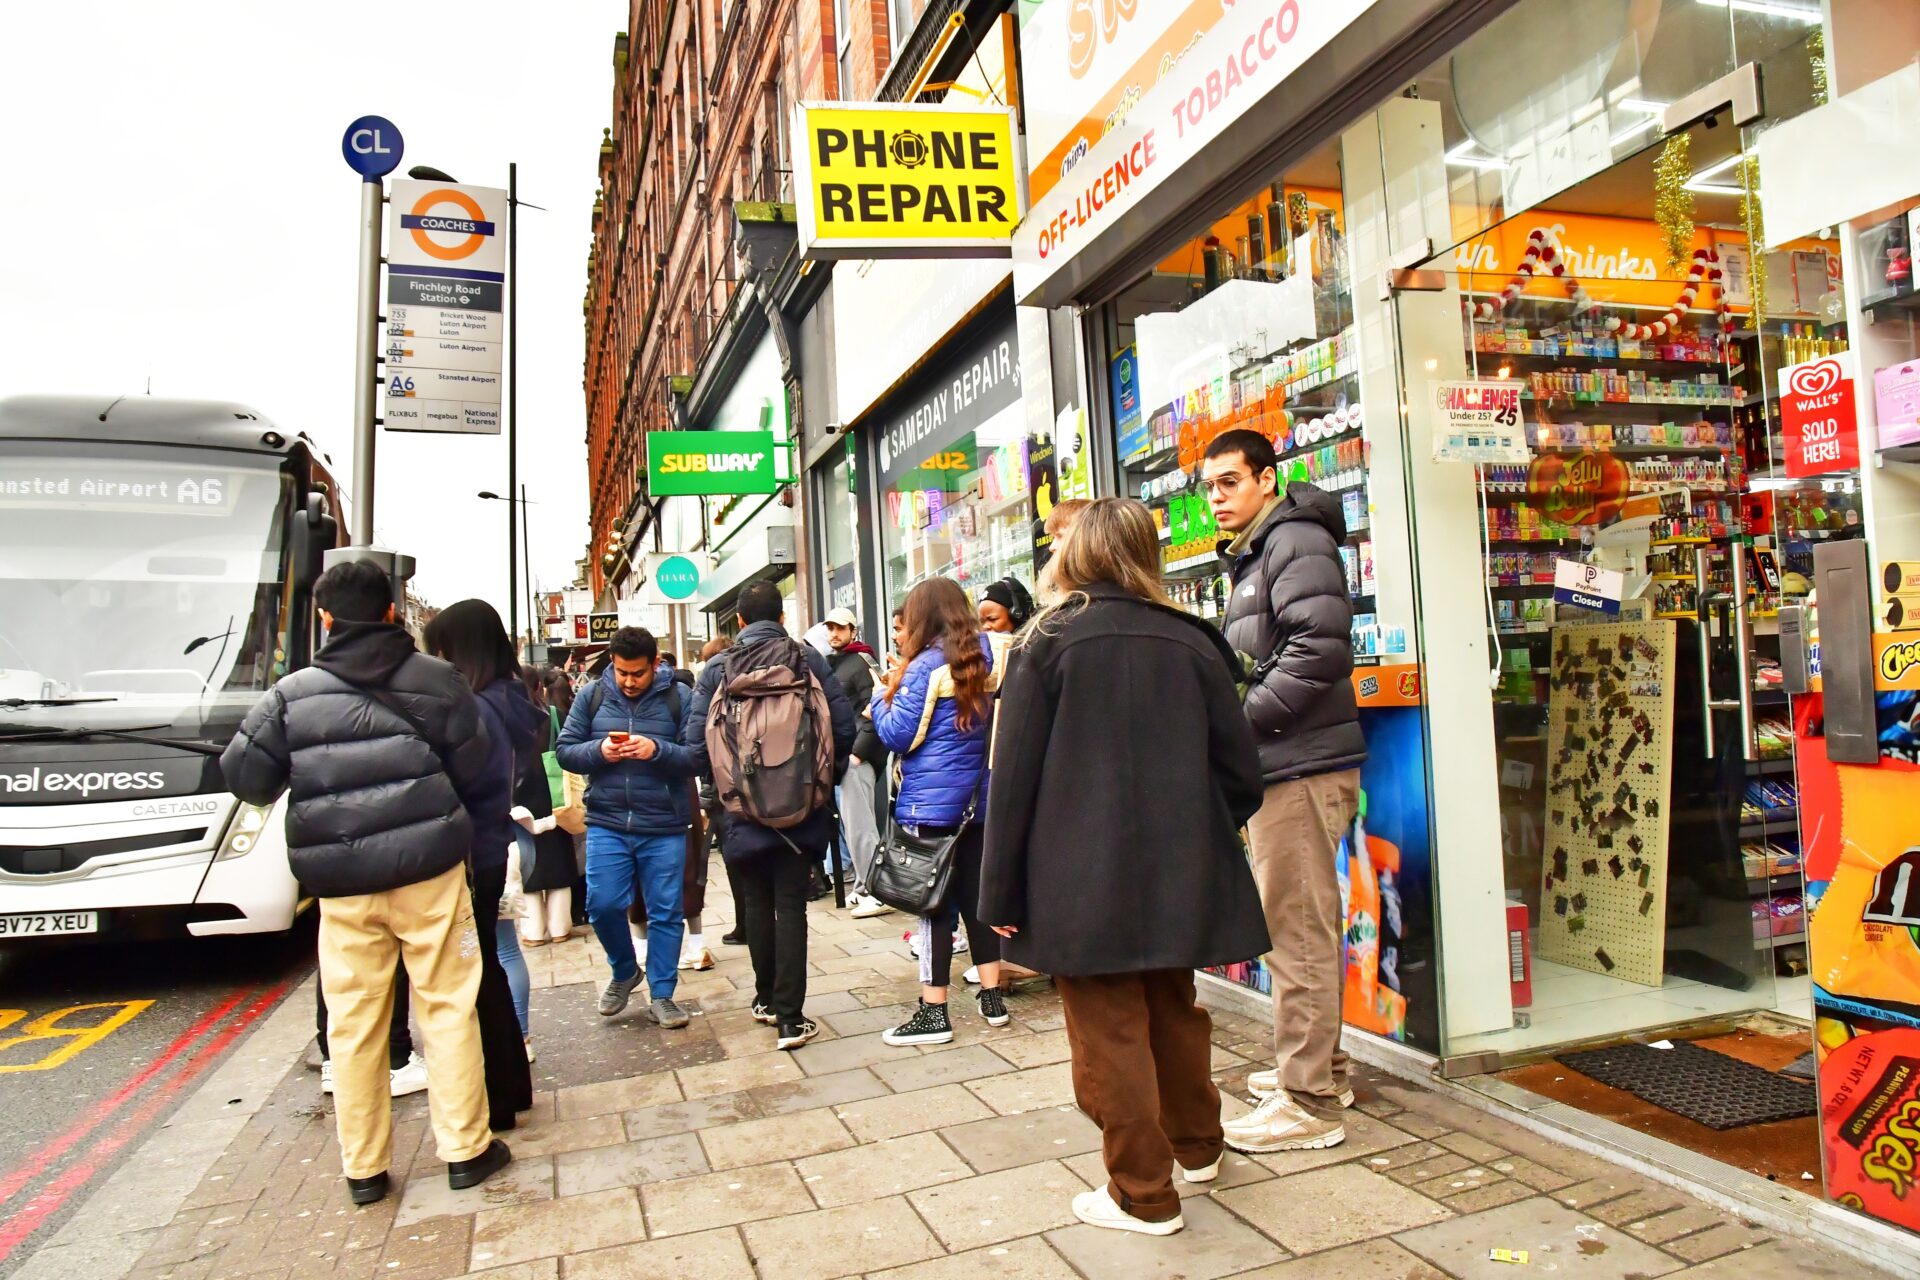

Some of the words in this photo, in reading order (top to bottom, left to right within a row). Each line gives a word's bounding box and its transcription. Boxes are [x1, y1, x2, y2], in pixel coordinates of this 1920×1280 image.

[1172, 0, 1300, 139] TOBACCO
[351, 129, 391, 154] CL
[821, 183, 1009, 223] REPAIR
[1038, 128, 1157, 259] OFF-LICENCE
[420, 217, 476, 232] COACHES
[409, 281, 453, 294] Finchley
[455, 284, 481, 295] Road
[420, 292, 457, 304] Station
[440, 311, 464, 320] Bricket
[466, 313, 487, 321] Wood
[462, 322, 487, 330] Airport
[439, 342, 460, 350] Luton
[461, 344, 487, 352] Airport
[390, 375, 415, 391] A6
[438, 374, 469, 382] Stansted
[471, 376, 496, 384] Airport
[891, 388, 948, 458] SAMEDAY
[953, 341, 1011, 414] REPAIR
[1437, 386, 1518, 411] CHALLENGE
[1796, 394, 1839, 412] WALL'S
[427, 412, 458, 420] megabus
[464, 409, 499, 418] National
[466, 417, 497, 426] Express
[1450, 411, 1475, 420] Under
[1477, 411, 1492, 420] 25?
[1494, 404, 1518, 427] 25
[1802, 418, 1838, 443] SOLD
[1029, 445, 1054, 465] Windows
[1803, 439, 1840, 465] HERE!
[659, 452, 764, 474] SUBWAY
[1558, 460, 1602, 489] Jelly
[80, 479, 168, 498] Airport
[177, 478, 222, 505] A6
[888, 489, 943, 530] VAPE
[1575, 582, 1602, 594] PayPoint
[1571, 593, 1603, 609] Closed
[594, 633, 610, 642] Nail
[44, 770, 165, 797] express
[133, 801, 218, 816] CAETANO
[52, 914, 89, 931] XEU
[1856, 1045, 1875, 1070] NET
[1847, 1068, 1865, 1086] WT
[1886, 1065, 1910, 1096] PEANUT
[1862, 1094, 1889, 1120] BUTTER
[1852, 1119, 1867, 1135] CUP
